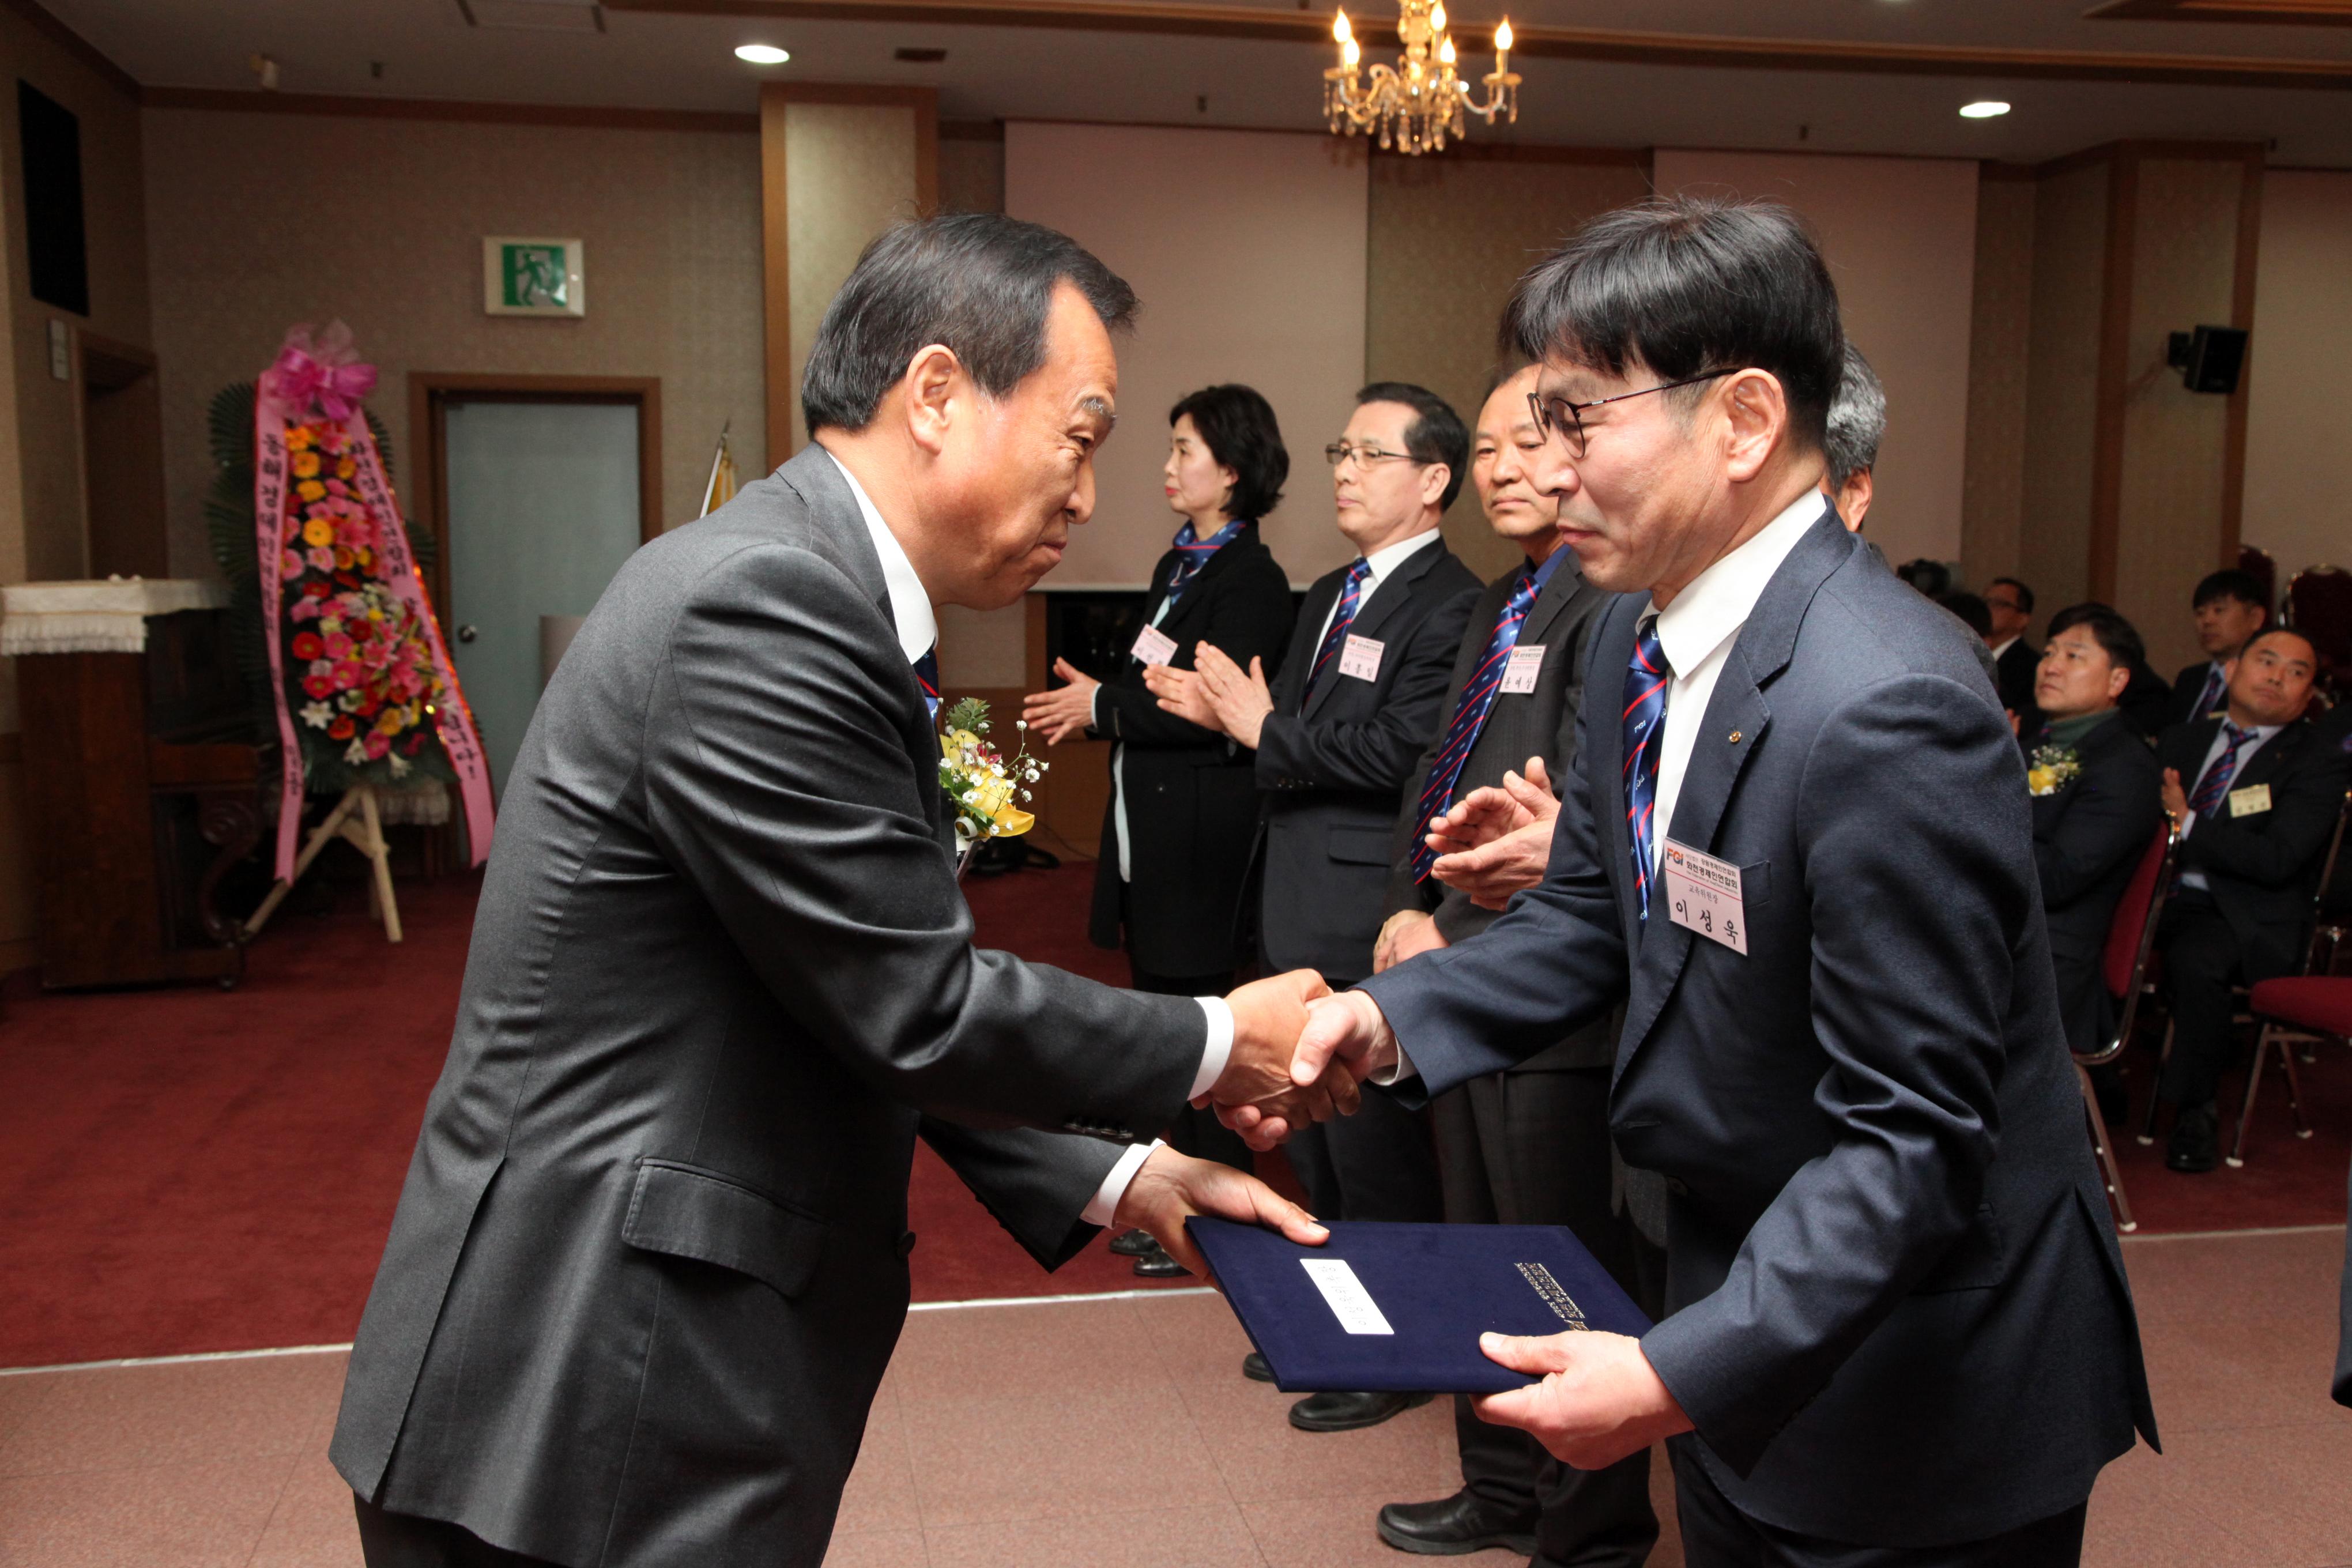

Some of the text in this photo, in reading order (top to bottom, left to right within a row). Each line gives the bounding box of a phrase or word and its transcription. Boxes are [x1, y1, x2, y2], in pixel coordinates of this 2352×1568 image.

[1634, 720, 1646, 733] FGI
[1667, 849, 1683, 866] FGI
[1686, 861, 1737, 889] 화천경제인연합회
[1689, 884, 1718, 904] 교육위원장
